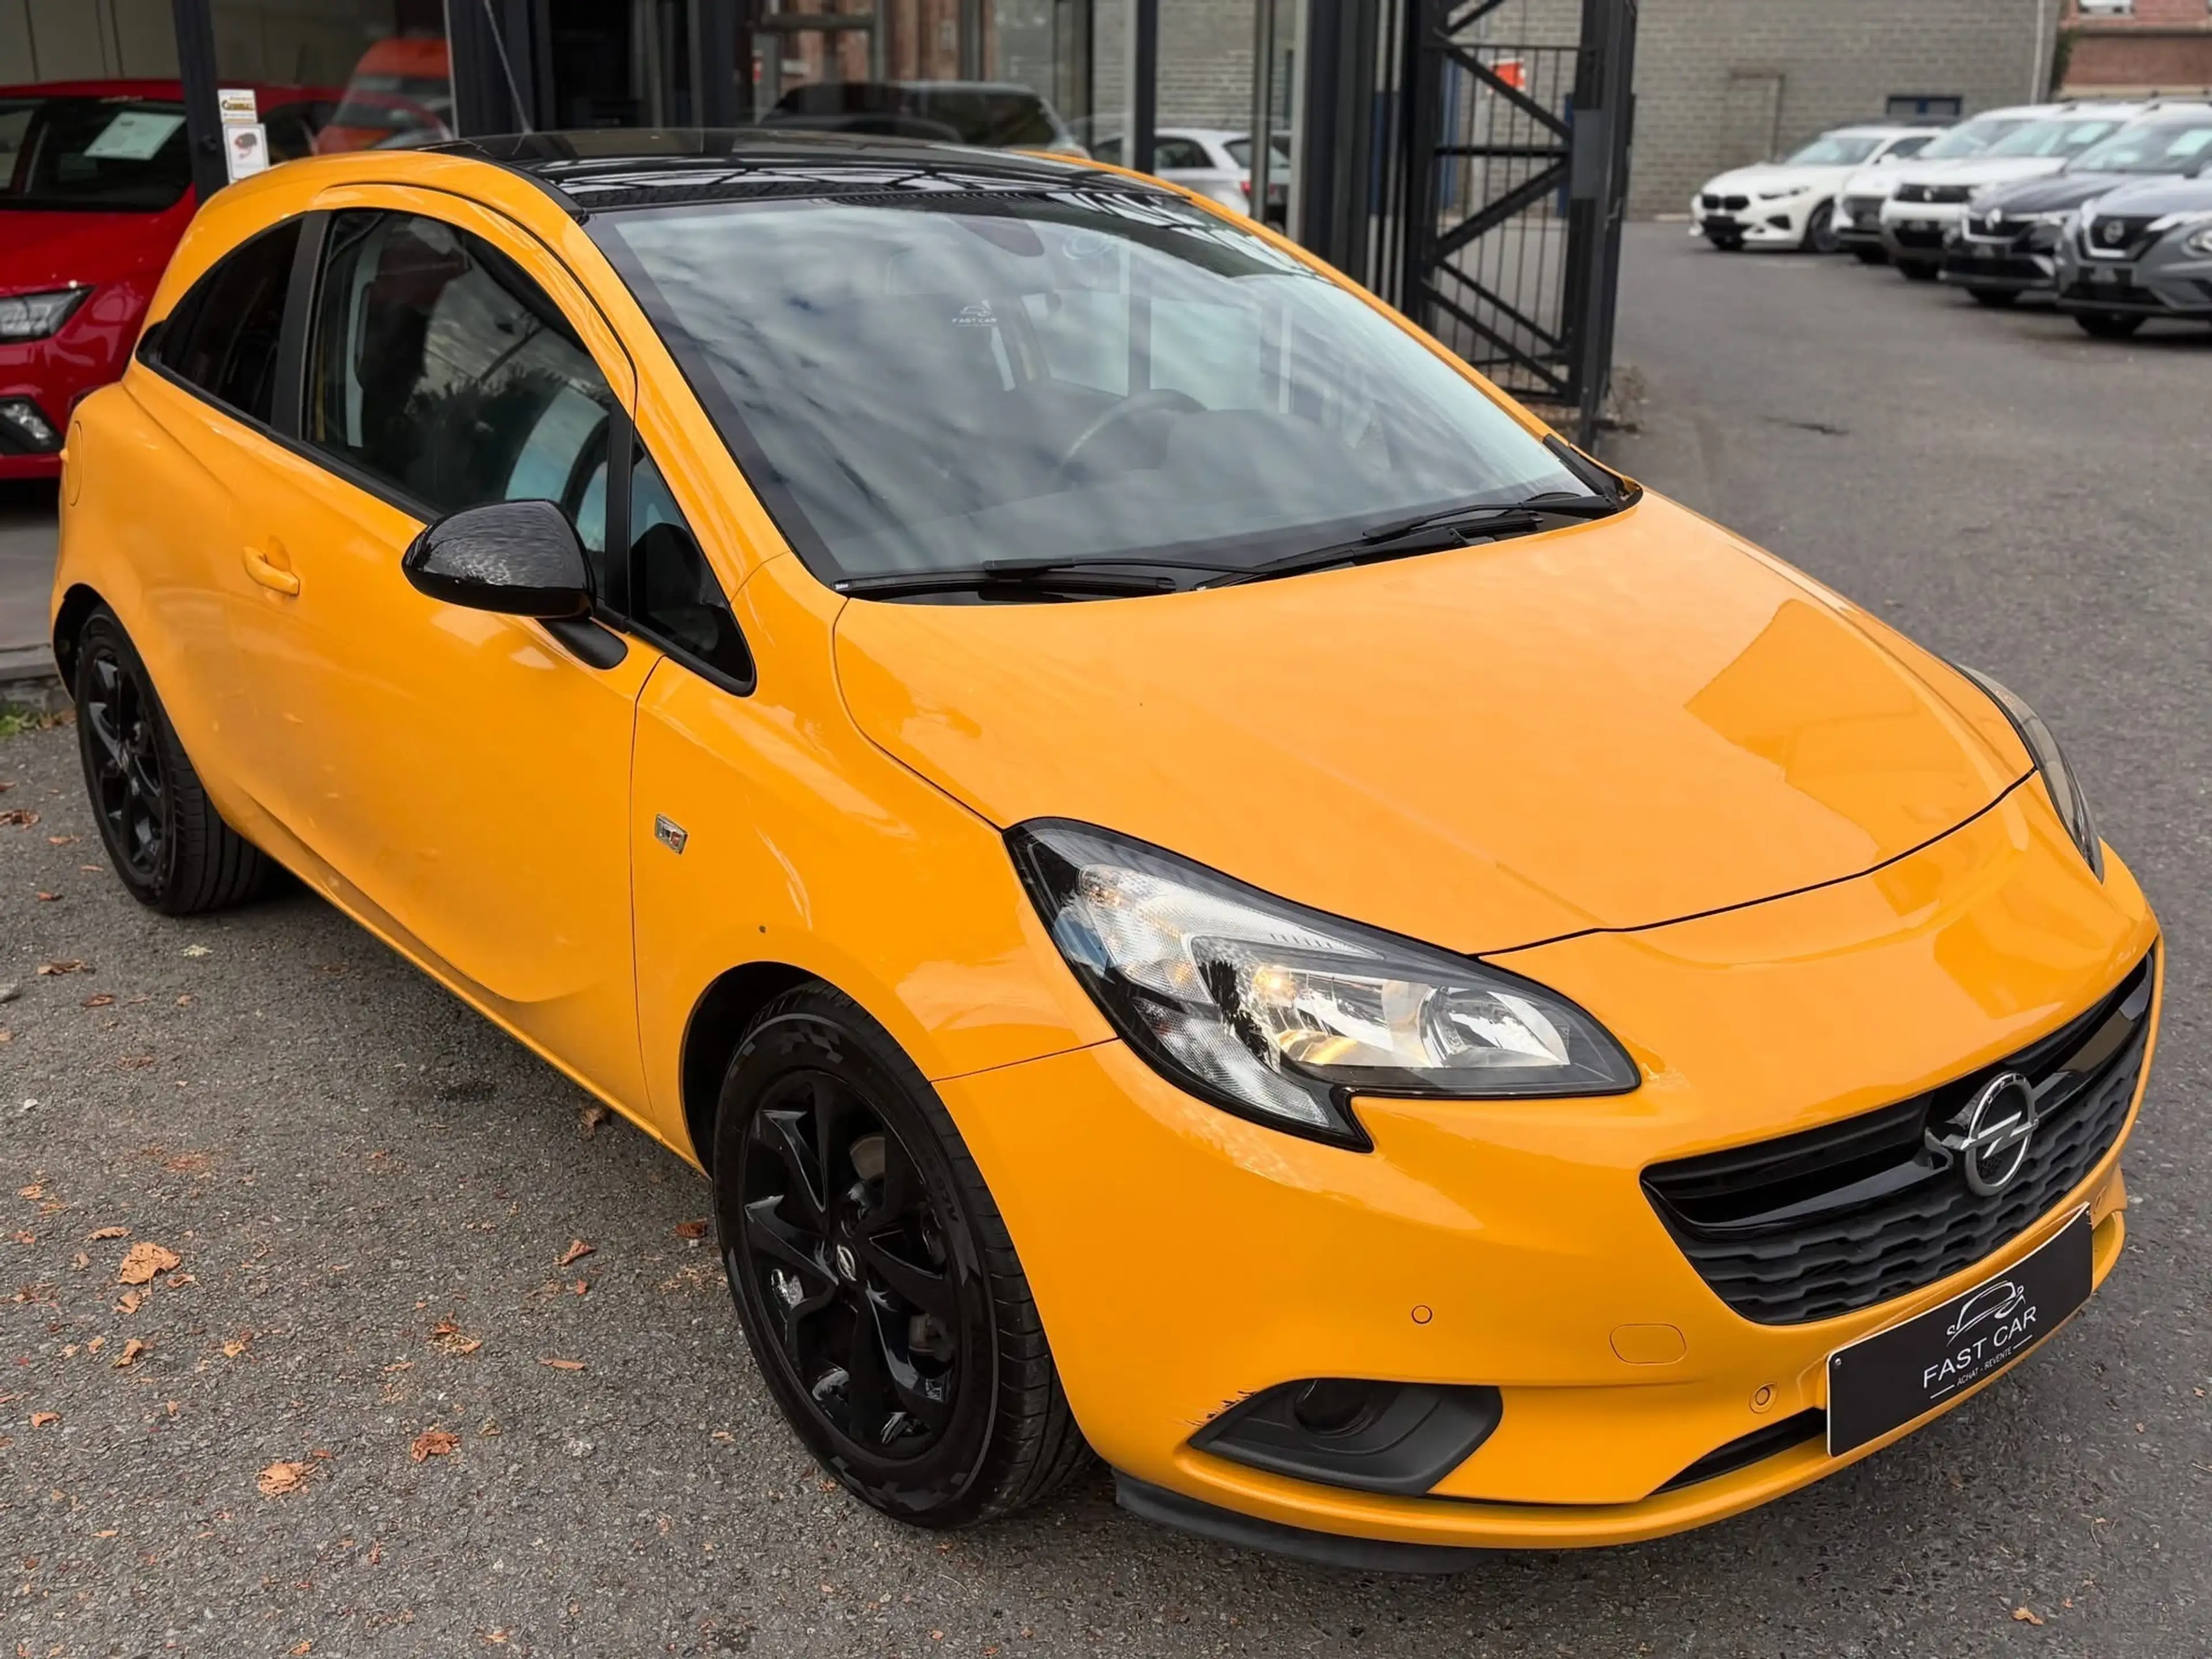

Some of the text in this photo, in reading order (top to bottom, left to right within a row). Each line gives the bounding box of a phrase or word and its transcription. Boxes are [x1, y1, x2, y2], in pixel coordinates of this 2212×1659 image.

[1923, 1305, 2037, 1389] FAST CAR
[1957, 1367, 1979, 1386] ACHAT
[1984, 1346, 2012, 1370] REVENTE
